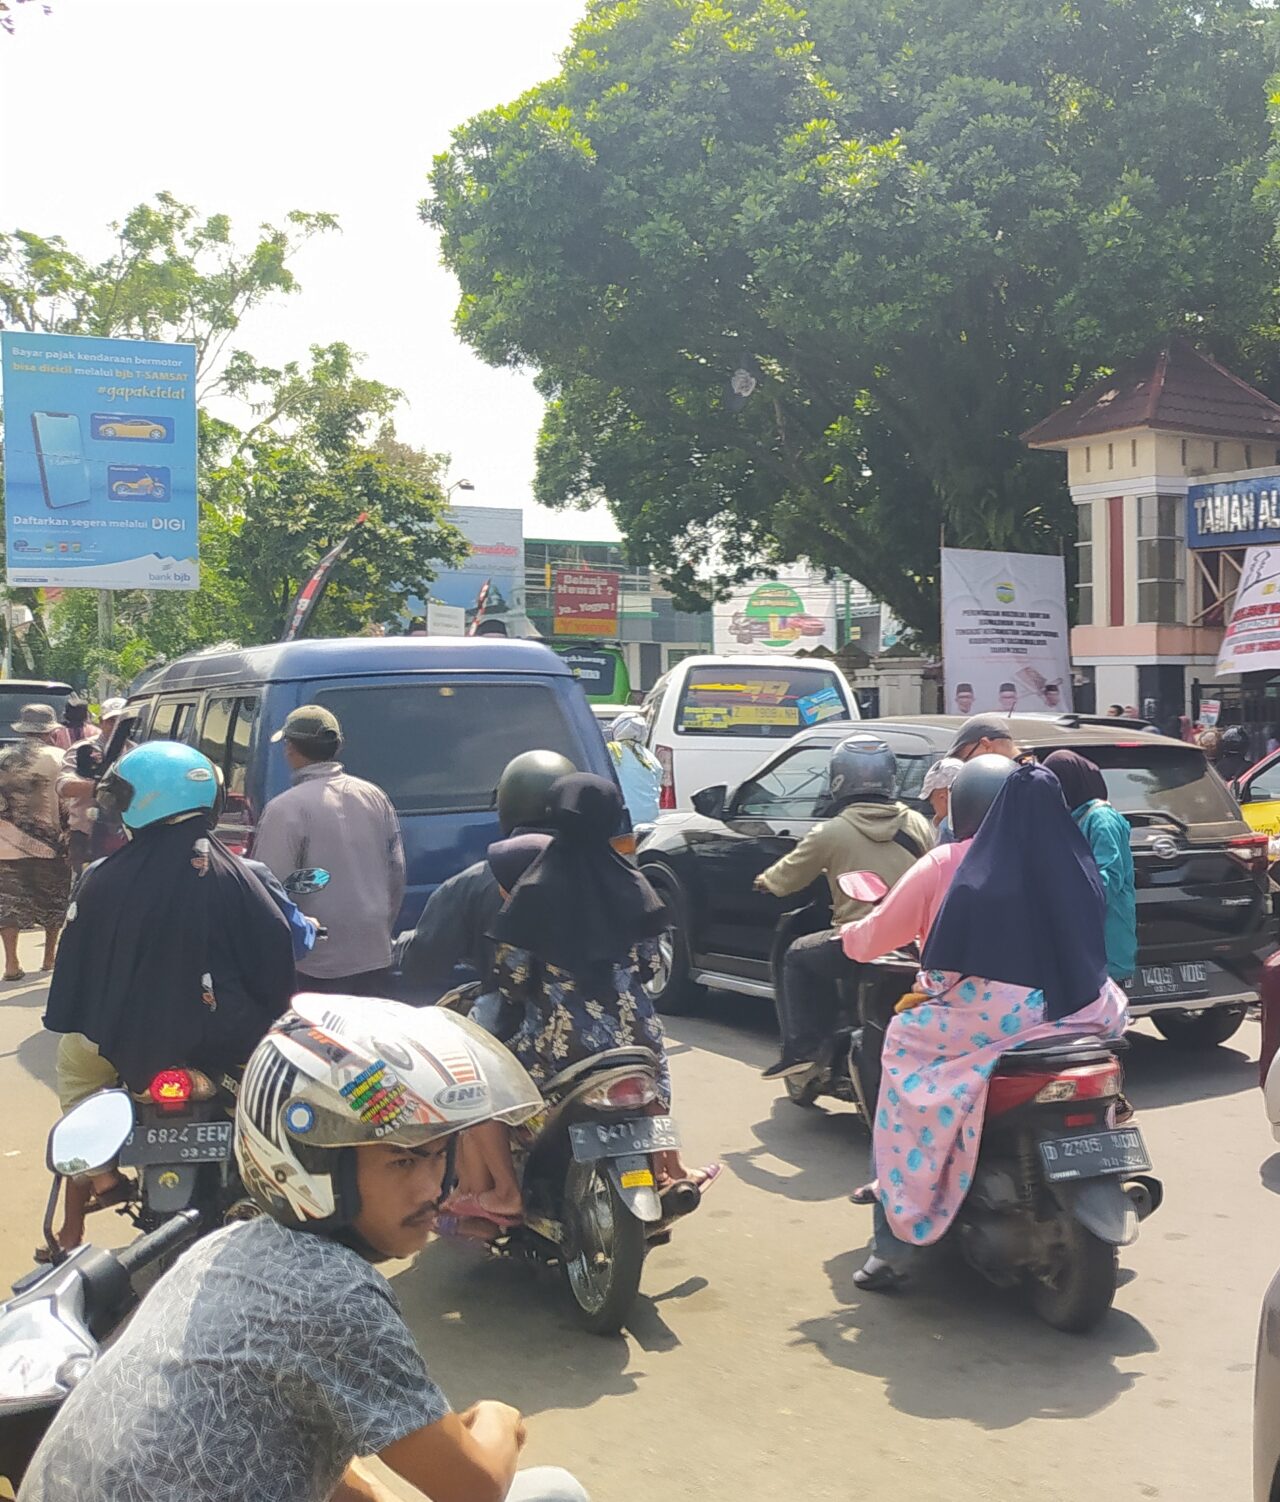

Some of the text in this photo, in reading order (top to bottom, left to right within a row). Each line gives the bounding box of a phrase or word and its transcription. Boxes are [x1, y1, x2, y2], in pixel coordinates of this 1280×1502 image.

[12, 347, 183, 367] Bayar pajak kendaraan bermotor
[74, 368, 113, 377] melalui
[1194, 492, 1255, 535] TAMAN
[13, 516, 186, 531] Daftarkan segera melalui DIGI
[148, 572, 191, 582] bank bjb
[147, 1128, 190, 1143] 6824
[197, 1126, 229, 1142] EEW
